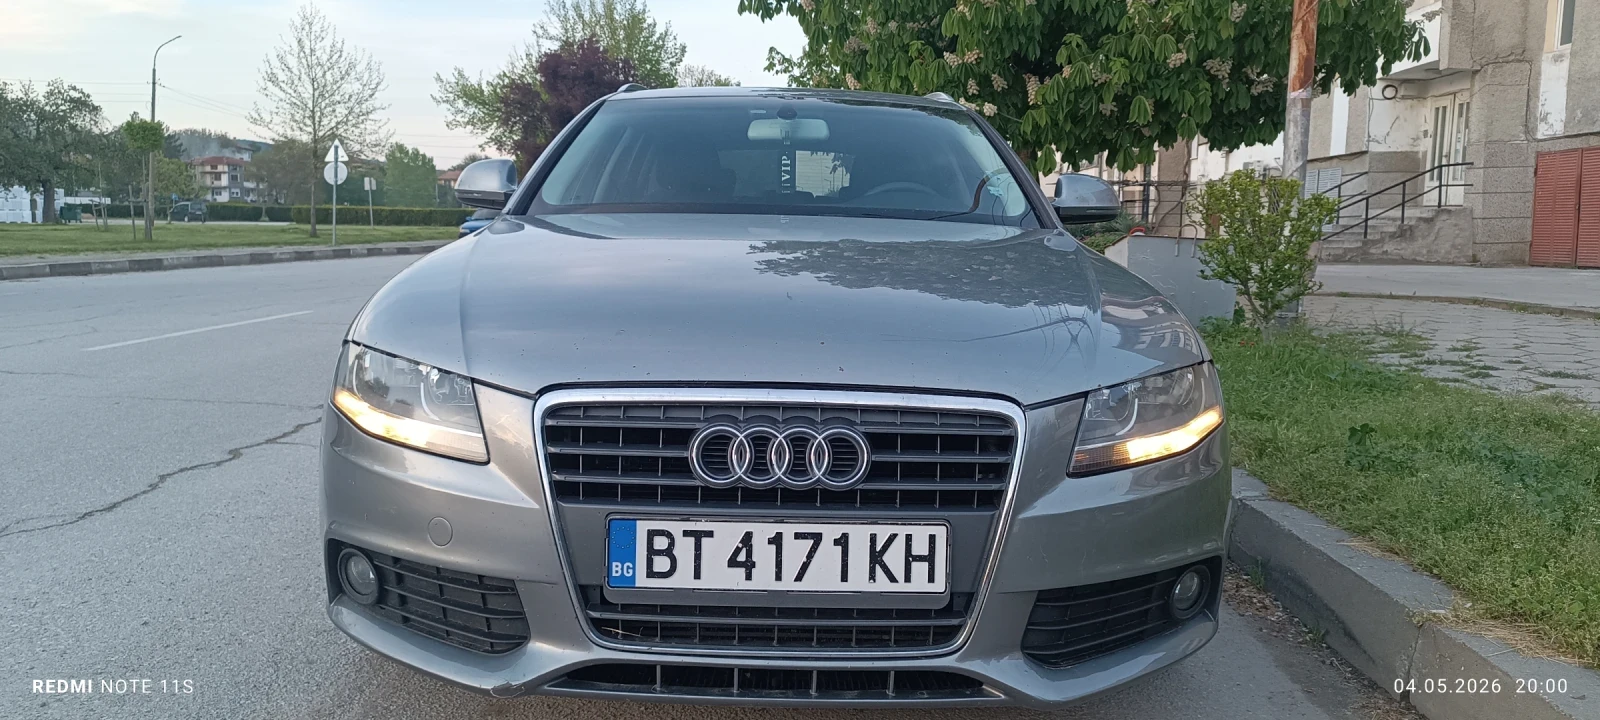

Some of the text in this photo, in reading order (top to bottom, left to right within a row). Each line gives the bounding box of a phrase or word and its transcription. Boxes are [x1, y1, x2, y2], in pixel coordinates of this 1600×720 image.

[781, 155, 791, 181] VIP
[611, 561, 634, 577] BG
[645, 528, 937, 584] BT 4171 KH
